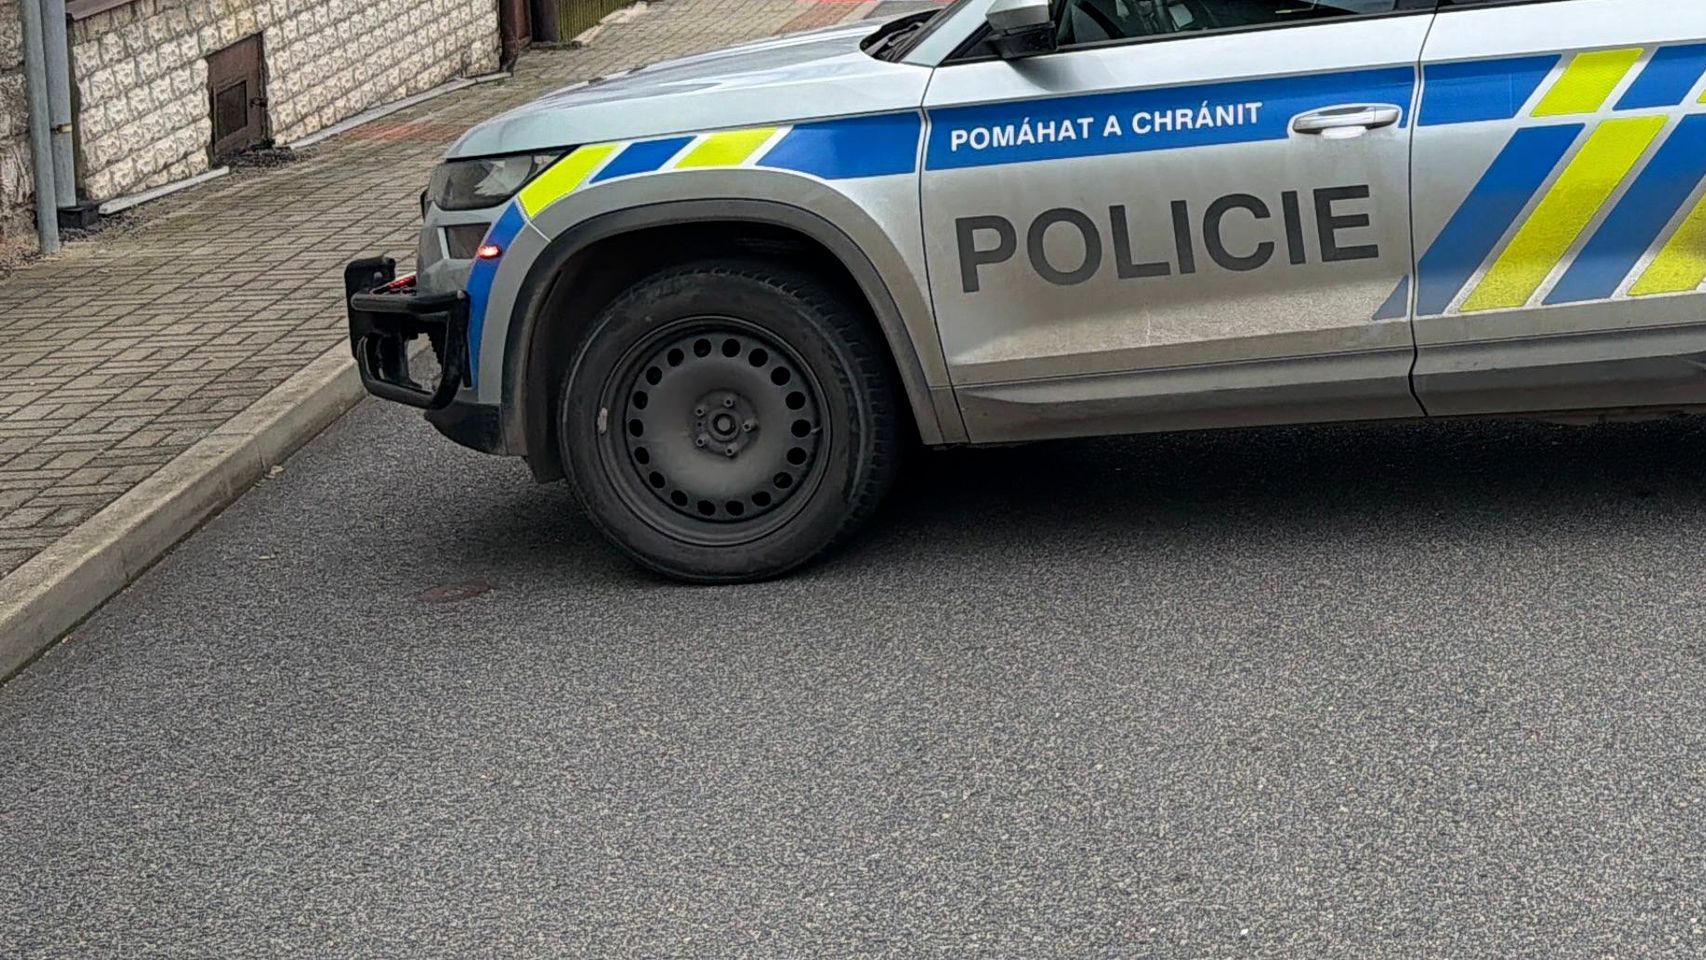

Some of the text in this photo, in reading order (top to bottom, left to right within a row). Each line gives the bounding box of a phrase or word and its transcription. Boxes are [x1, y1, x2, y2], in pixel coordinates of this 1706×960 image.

[950, 100, 1262, 152] POMÁHAT A CHRÁNIT
[955, 184, 1379, 293] POLICIE
